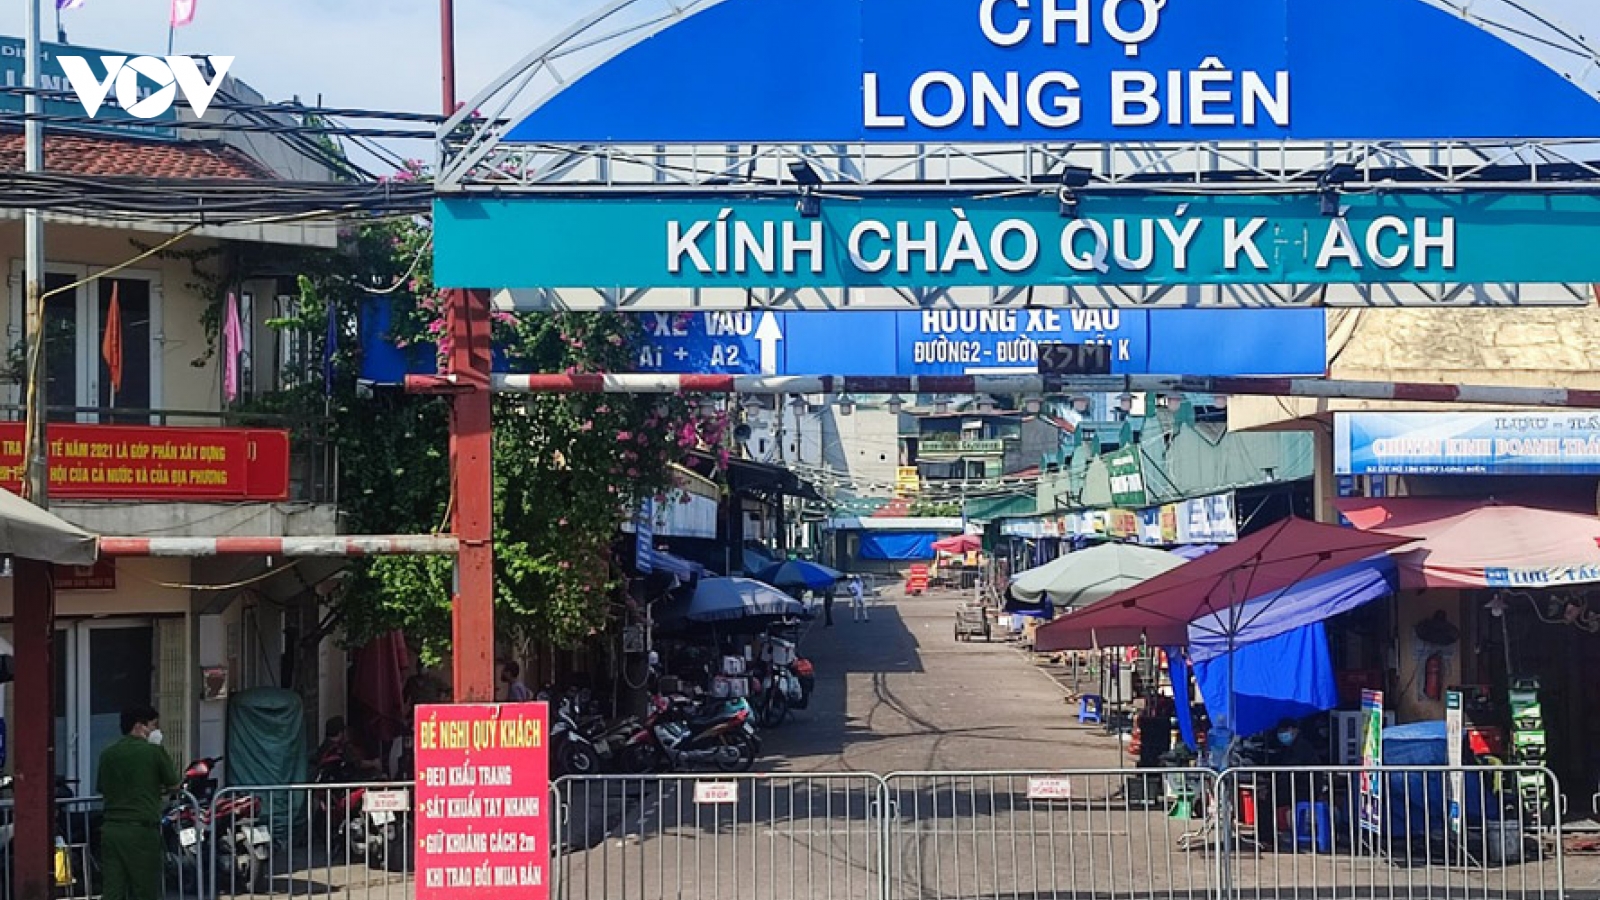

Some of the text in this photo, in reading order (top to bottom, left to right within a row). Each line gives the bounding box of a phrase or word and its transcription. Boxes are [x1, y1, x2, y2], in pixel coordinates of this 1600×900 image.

[979, 0, 1165, 56] CHỢ
[862, 56, 1290, 127] LONG BIÊN
[666, 207, 823, 273] KÍNH
[848, 207, 1039, 272] CHÀO
[1060, 203, 1201, 273] QUÝ
[710, 344, 740, 367] A2
[1446, 438, 1491, 456] KINH
[1496, 438, 1559, 456] DOANH
[440, 720, 469, 756] NGHỊ
[500, 713, 541, 748] KHÁCH
[478, 765, 513, 786] TRANG
[426, 794, 446, 819] SÁT
[483, 797, 502, 818] TAY
[504, 797, 540, 817] NHANH
[489, 828, 518, 853] CÁCH
[427, 867, 444, 888] KHI
[445, 867, 473, 888] TRAO
[494, 866, 518, 886] MUA
[519, 860, 542, 886] BÁN
